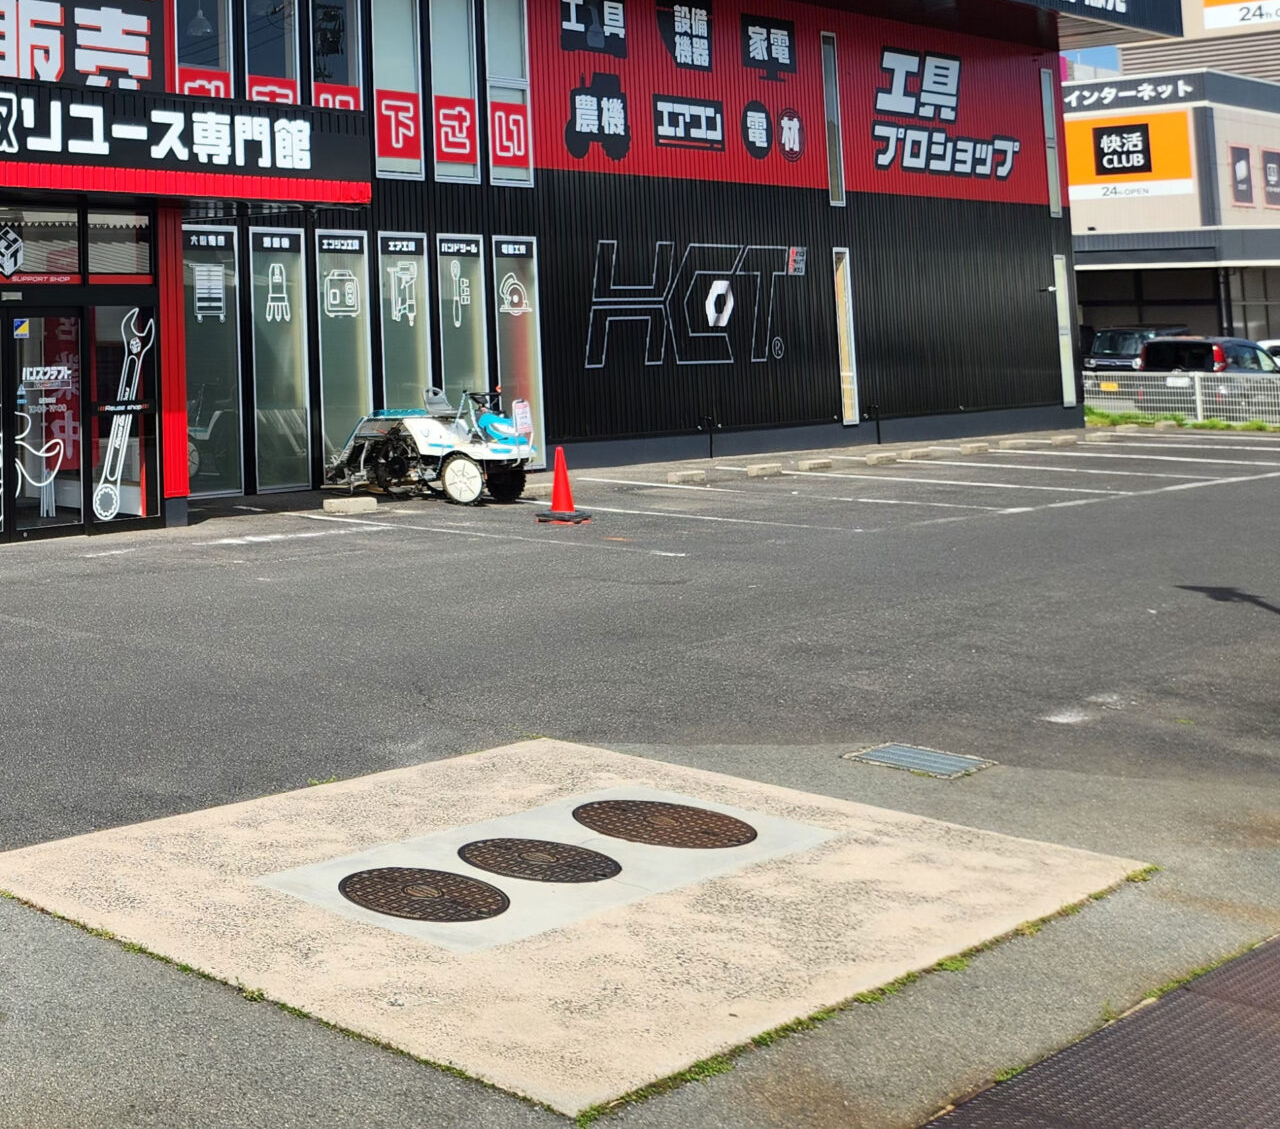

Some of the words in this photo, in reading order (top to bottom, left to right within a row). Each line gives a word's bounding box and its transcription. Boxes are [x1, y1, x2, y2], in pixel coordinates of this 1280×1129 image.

[673, 4, 708, 38] 設備
[675, 35, 710, 67] 機器
[747, 26, 791, 65] 家電
[876, 51, 961, 120] 工具
[1063, 80, 1194, 107] インターネット
[575, 94, 626, 136] 農機
[656, 101, 723, 141] エアコン
[873, 124, 1021, 177] プロショップ
[1100, 132, 1144, 154] 快活
[1102, 153, 1145, 169] CLUB
